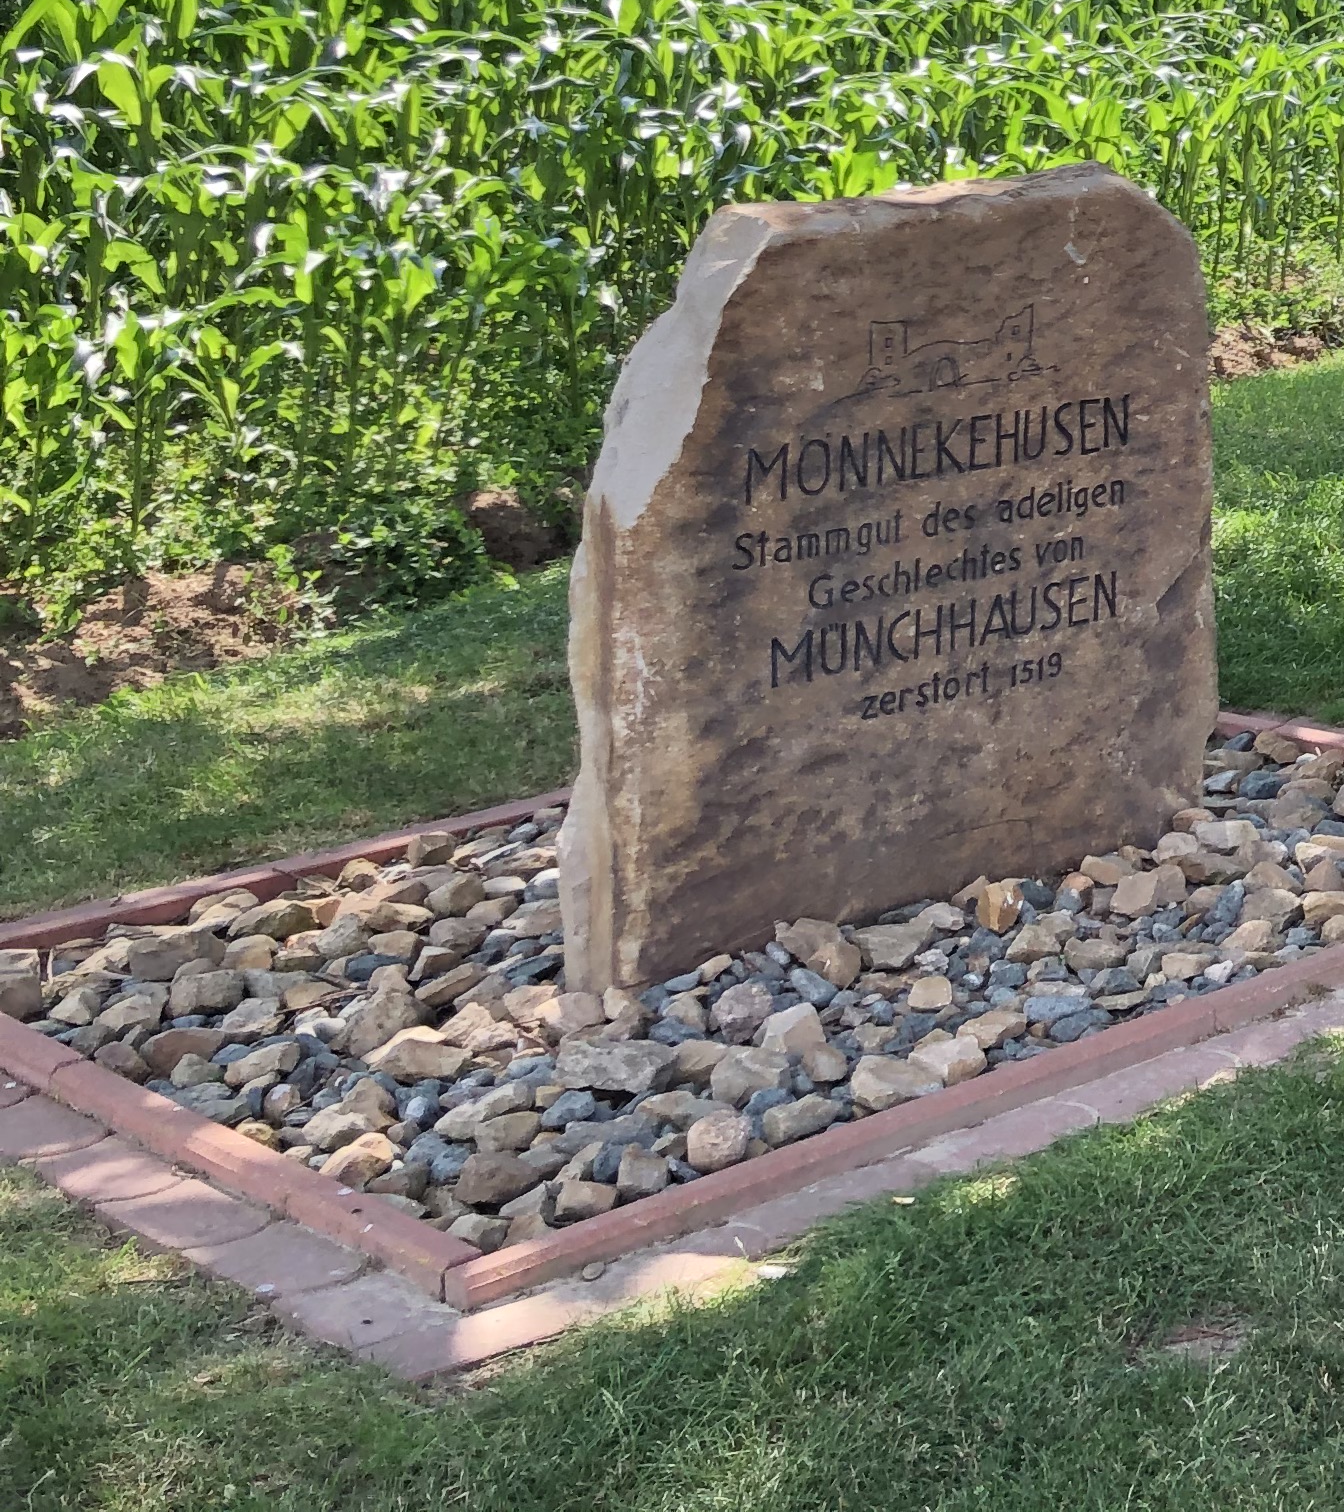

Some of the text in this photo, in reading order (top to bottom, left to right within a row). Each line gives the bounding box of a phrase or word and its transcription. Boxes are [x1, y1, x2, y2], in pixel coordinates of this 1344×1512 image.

[731, 477, 1126, 571] Stammgut des adeligen
[808, 535, 1085, 610] Geschlechtes von
[770, 570, 1118, 689] MÜNCHHAUSEN
[861, 652, 1063, 721] zerstört 1519
